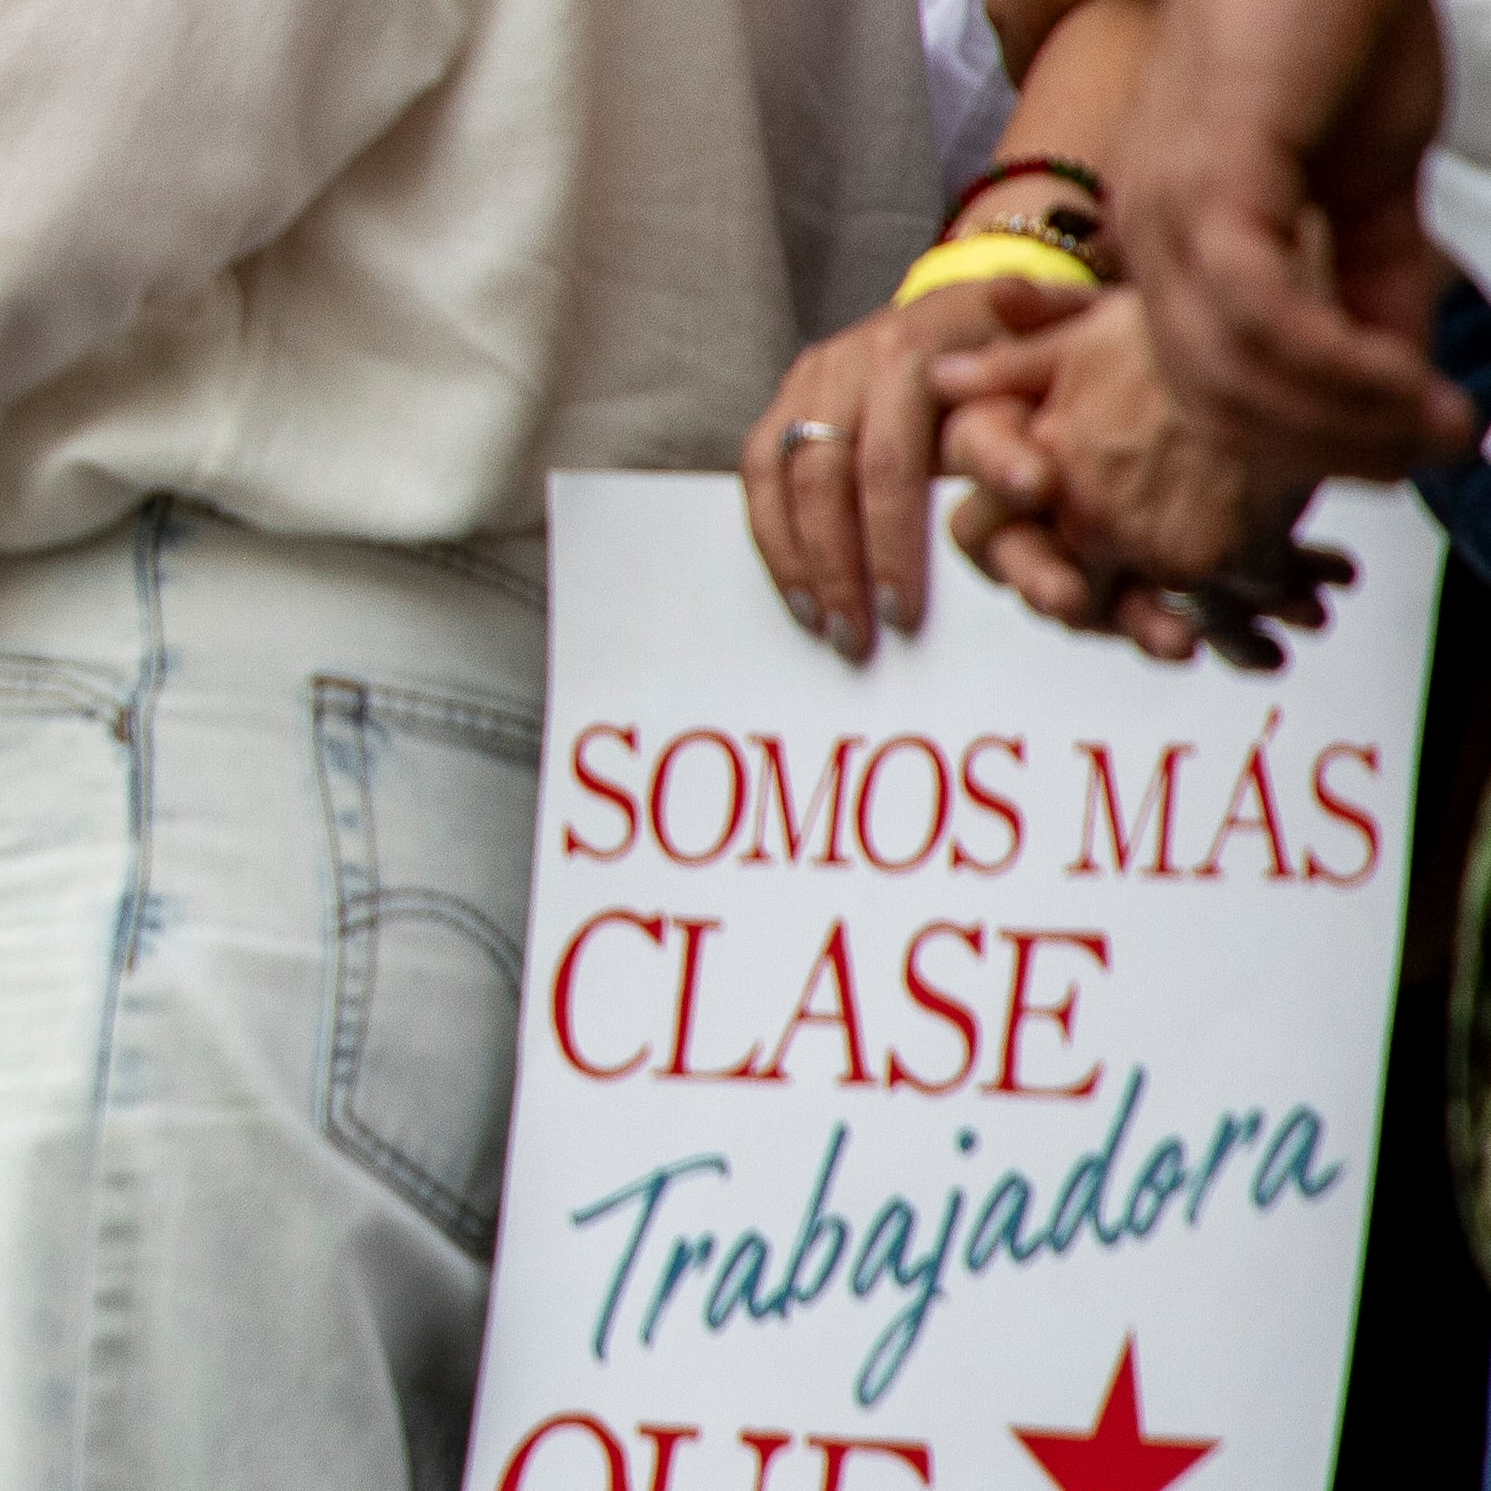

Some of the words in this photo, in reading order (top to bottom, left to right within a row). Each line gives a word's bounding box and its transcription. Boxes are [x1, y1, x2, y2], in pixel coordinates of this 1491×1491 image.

[561, 723, 1027, 875] SOMOS
[1067, 708, 1384, 886] MÁS
[549, 907, 1113, 1102] CLASE
[570, 1064, 1347, 1409] Trabajadora
